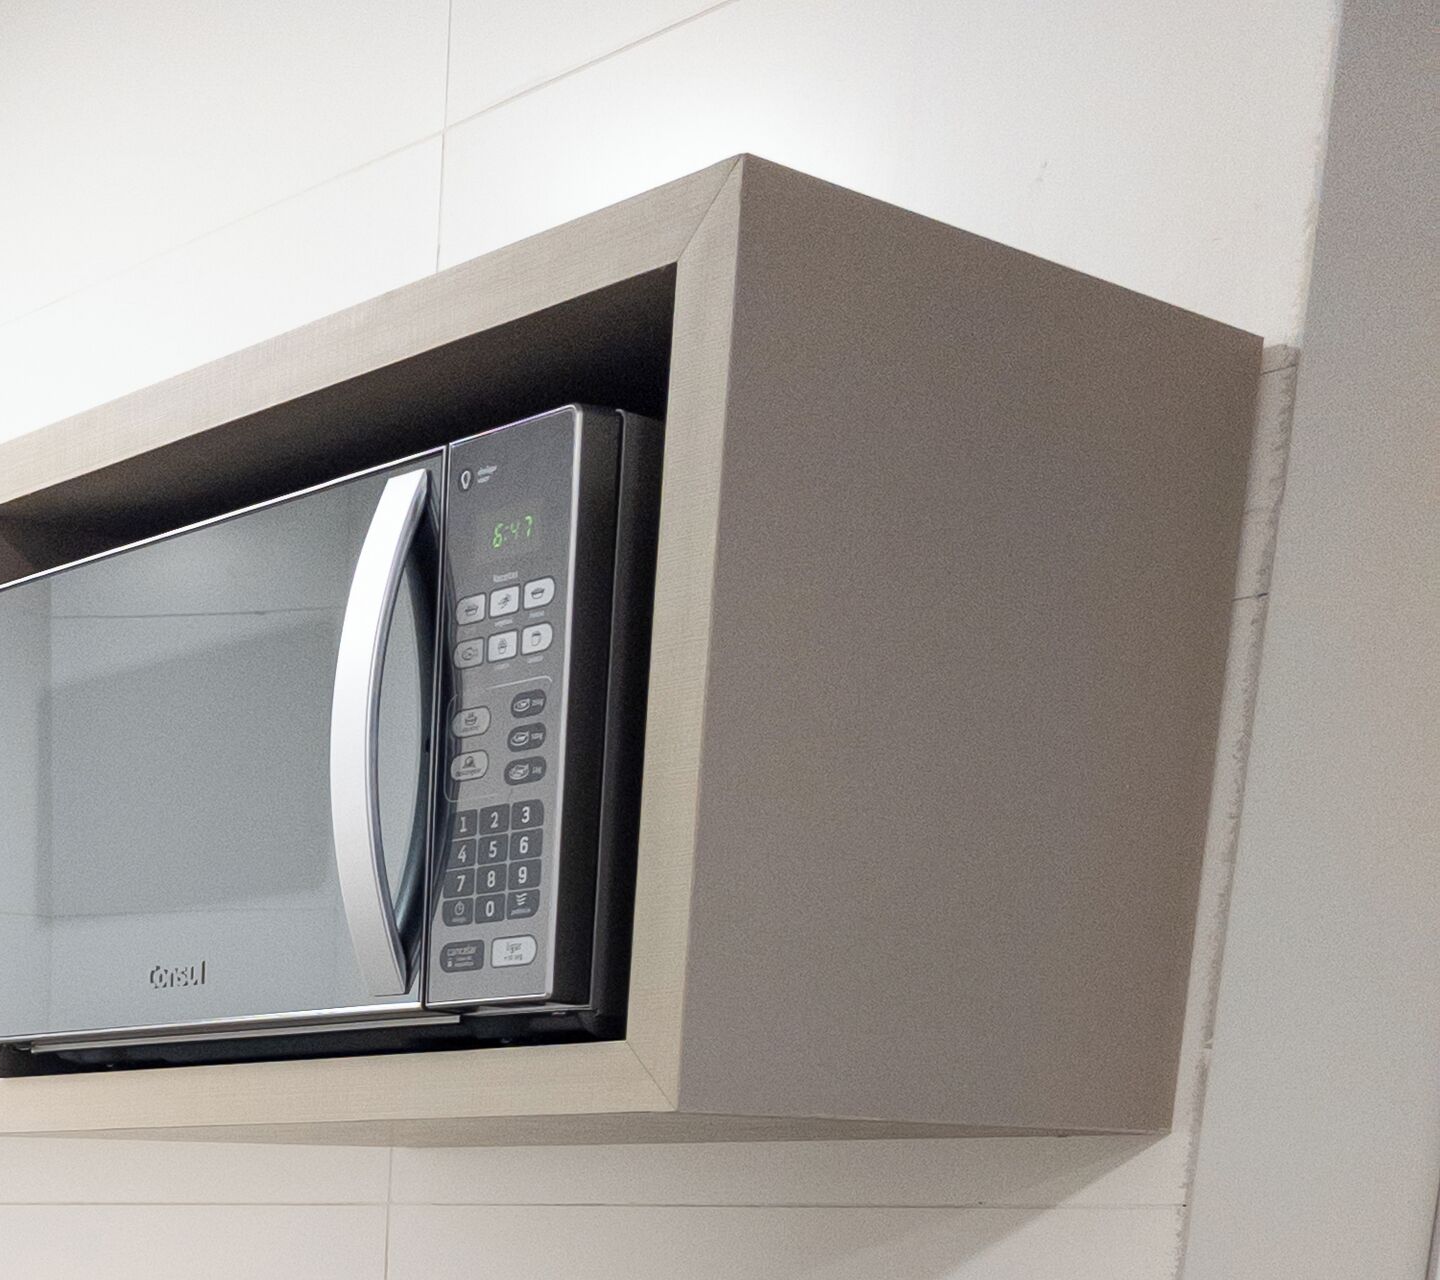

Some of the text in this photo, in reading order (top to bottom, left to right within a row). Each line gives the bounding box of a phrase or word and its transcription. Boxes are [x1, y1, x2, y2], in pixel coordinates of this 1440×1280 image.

[490, 811, 499, 829] 2
[521, 806, 530, 823] 3
[459, 816, 467, 832] 1
[489, 841, 497, 858] 5
[520, 836, 529, 853] 6
[458, 845, 467, 863] 4
[457, 875, 466, 892] 7
[487, 870, 496, 888] 8
[518, 866, 527, 884] 9
[486, 900, 495, 917] 0
